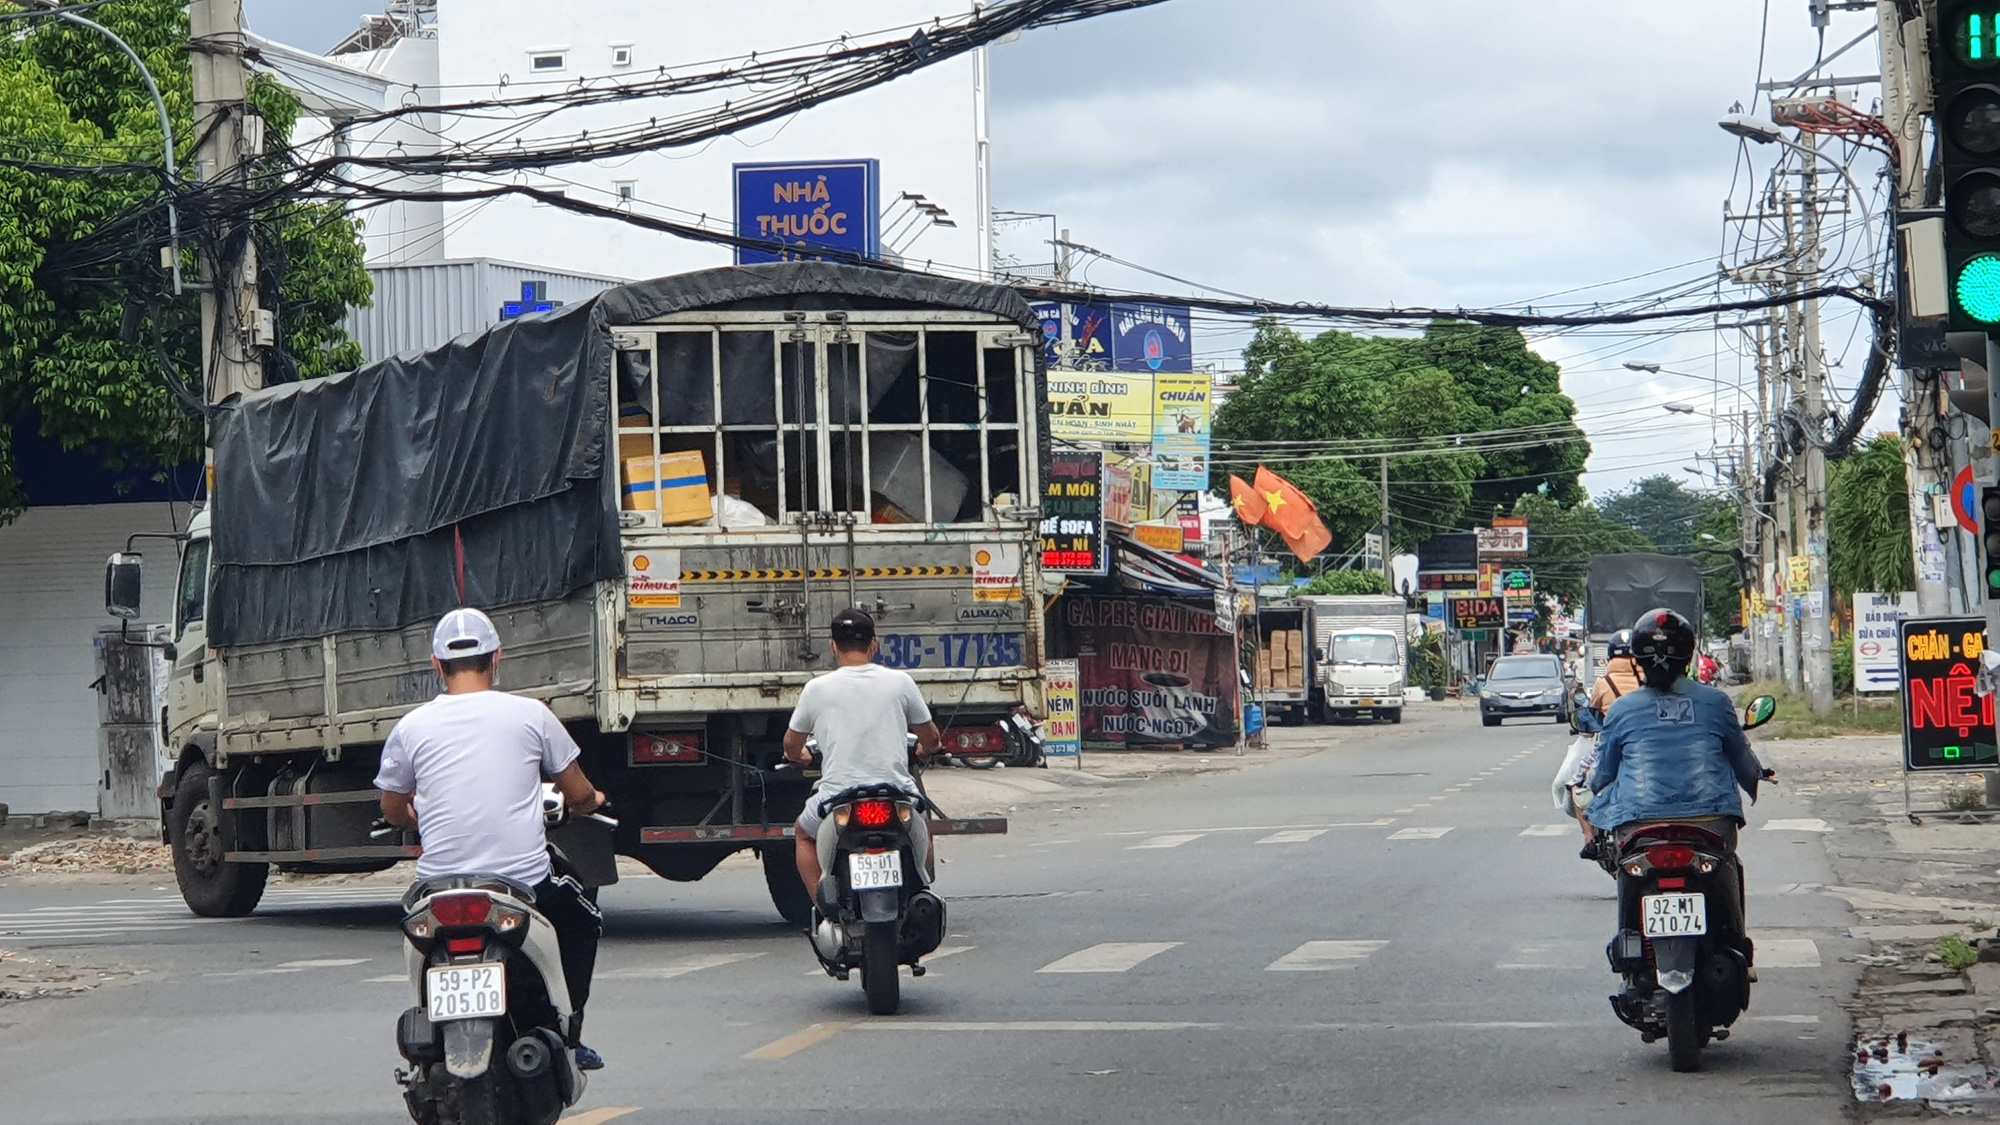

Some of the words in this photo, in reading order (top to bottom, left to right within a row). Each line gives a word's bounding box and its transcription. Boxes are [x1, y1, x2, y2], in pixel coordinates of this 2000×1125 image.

[774, 175, 830, 203] NHÀ
[756, 202, 848, 237] THUỐC
[1166, 315, 1187, 343] MAU
[1047, 381, 1087, 394] NINH
[1090, 379, 1128, 395] BÌNH
[1159, 387, 1206, 402] CHUẨN
[1066, 481, 1095, 496] MỚI
[1060, 520, 1094, 534] SOFA
[631, 582, 679, 590] RIMULA
[975, 576, 1019, 584] RIMULA
[961, 609, 1011, 619] AUMAN
[1067, 596, 1095, 627] CÀ
[1456, 599, 1501, 617] BIDA
[646, 616, 697, 625] THACO
[1457, 617, 1477, 628] T2
[1907, 629, 1950, 661] CHĂN
[1110, 642, 1165, 673] MANG
[1168, 648, 1191, 674] ĐI
[1151, 716, 1196, 740] NGỌT
[1653, 898, 1694, 915] 92-M1
[1648, 915, 1702, 933] 210.74
[439, 968, 493, 992] 59-P2
[433, 990, 500, 1016] 205.08
